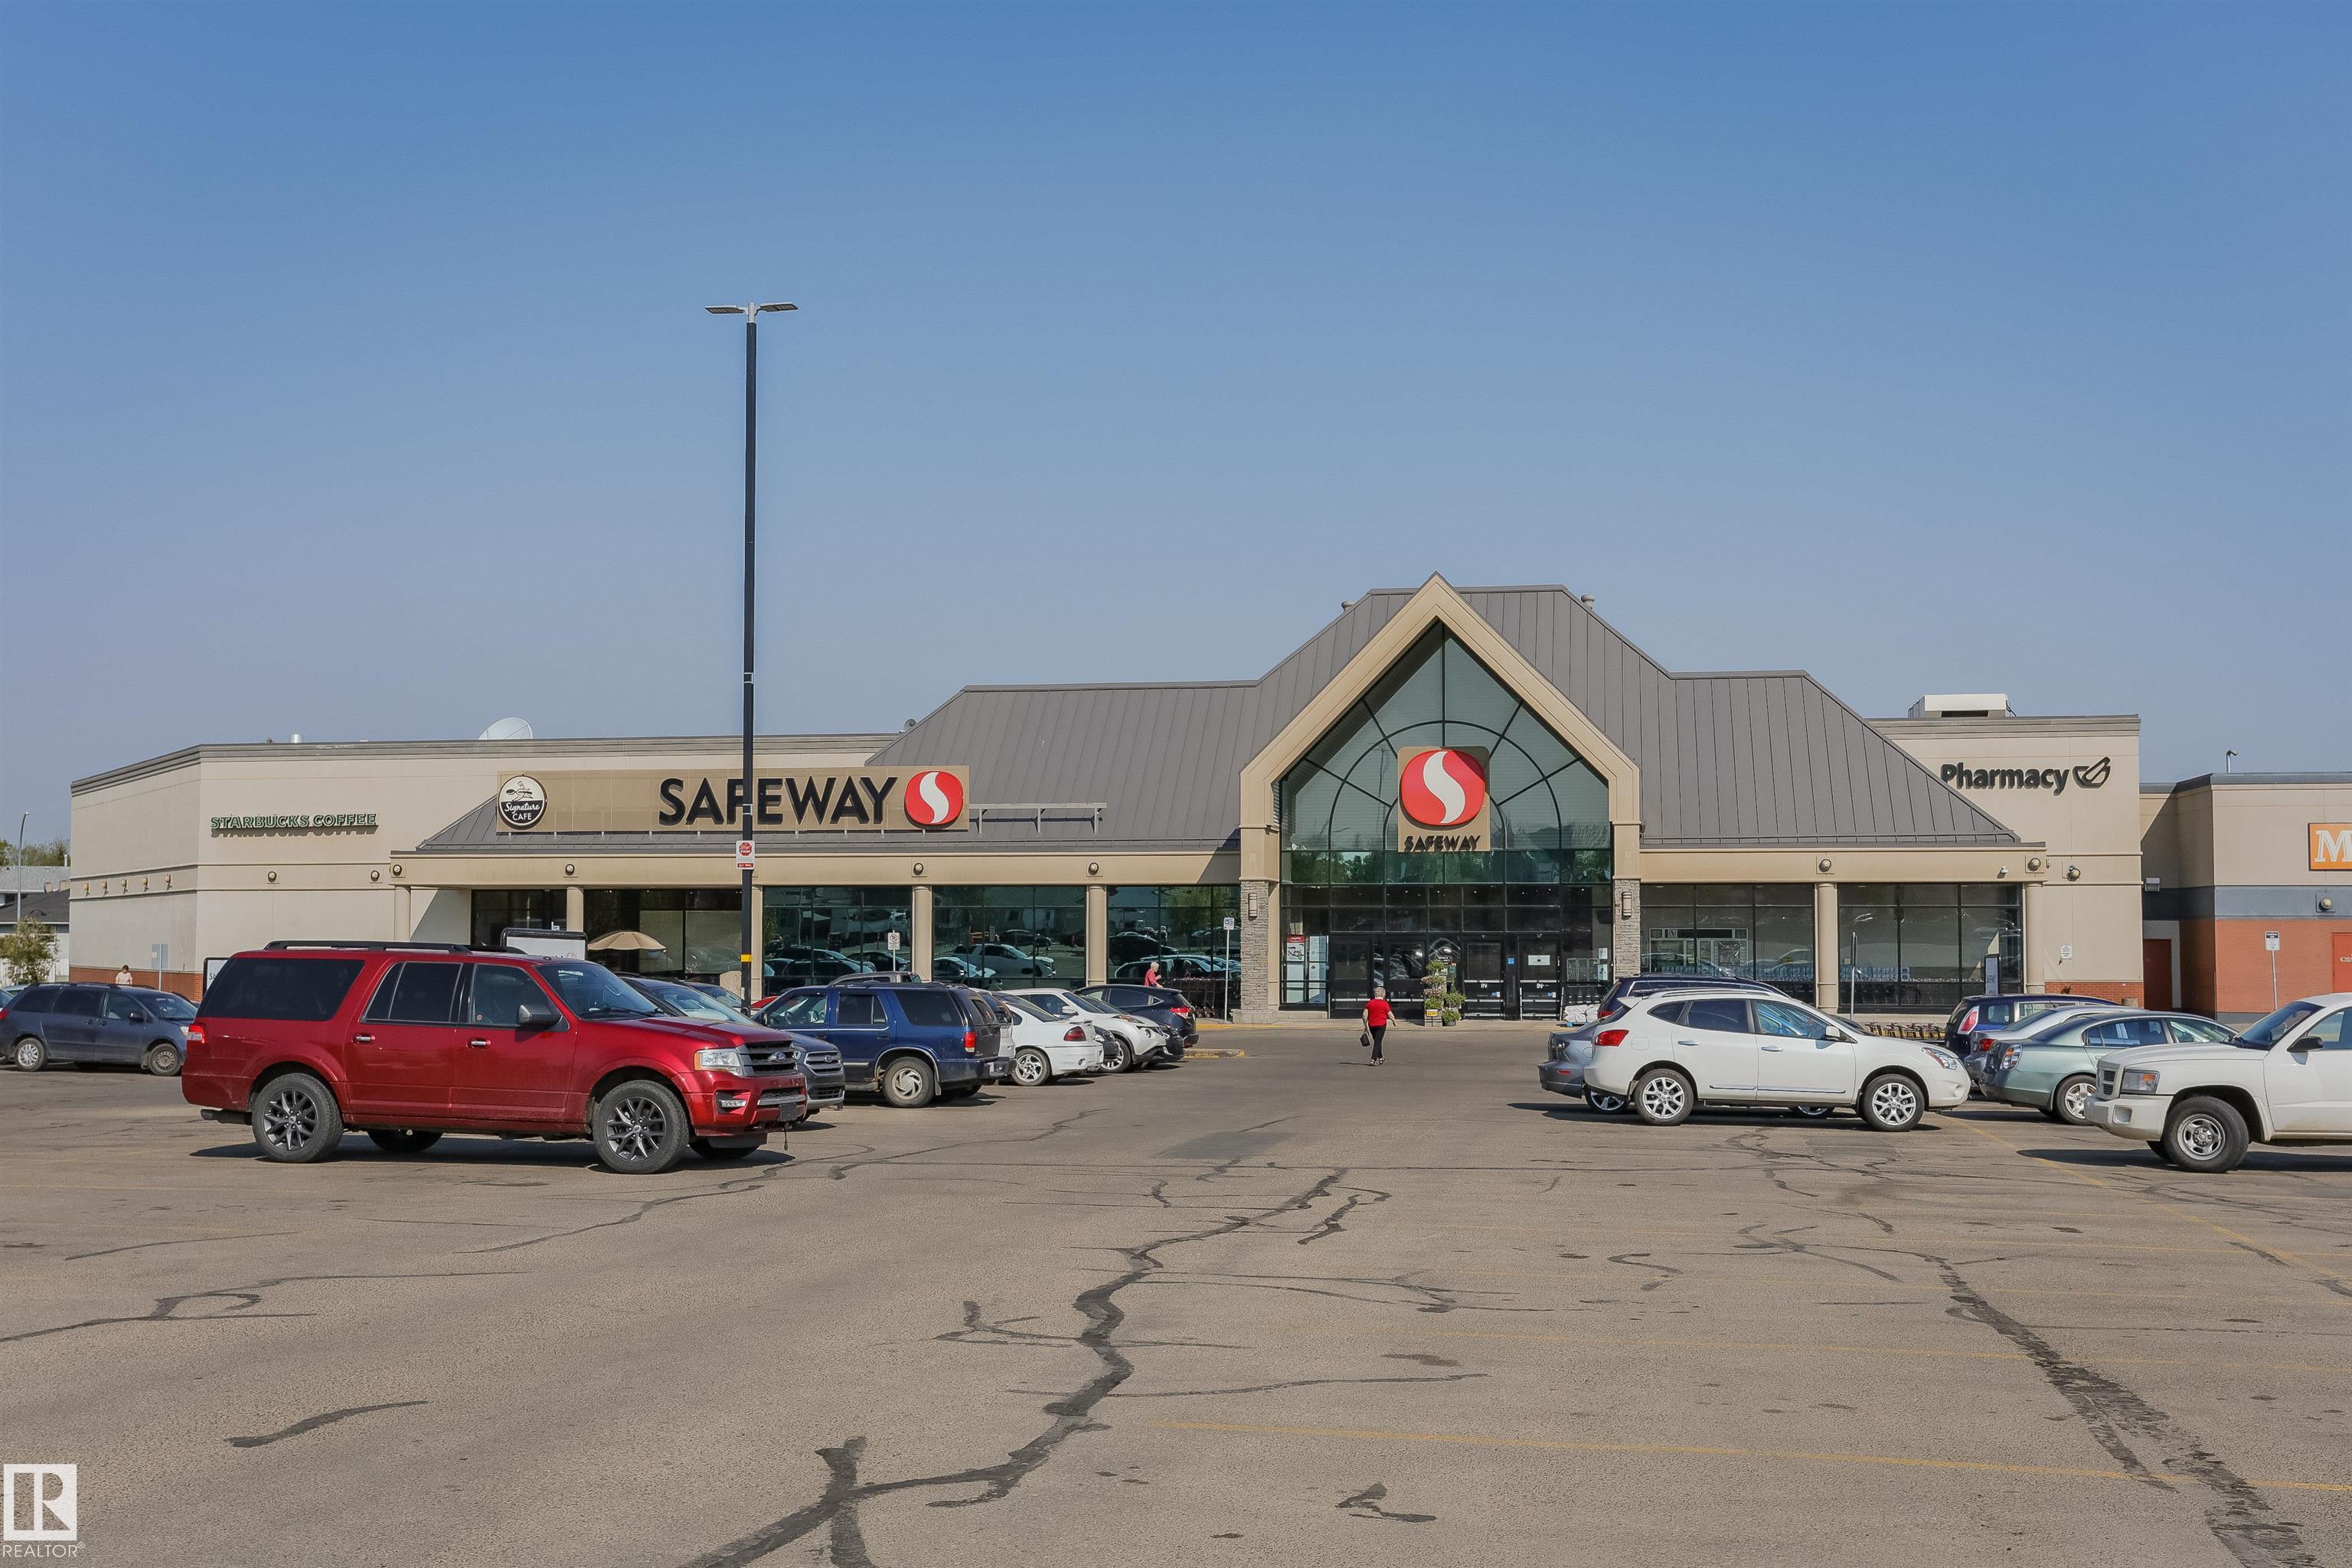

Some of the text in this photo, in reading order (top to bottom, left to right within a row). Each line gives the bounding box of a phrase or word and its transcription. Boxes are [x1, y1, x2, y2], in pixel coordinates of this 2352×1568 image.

[1940, 762, 2070, 796] Pharmacy
[505, 802, 541, 814] Signature
[658, 776, 899, 825] SAFEWAY
[211, 813, 377, 828] STARBUCKS COFFEE
[1403, 835, 1481, 852] SAFEWAY
